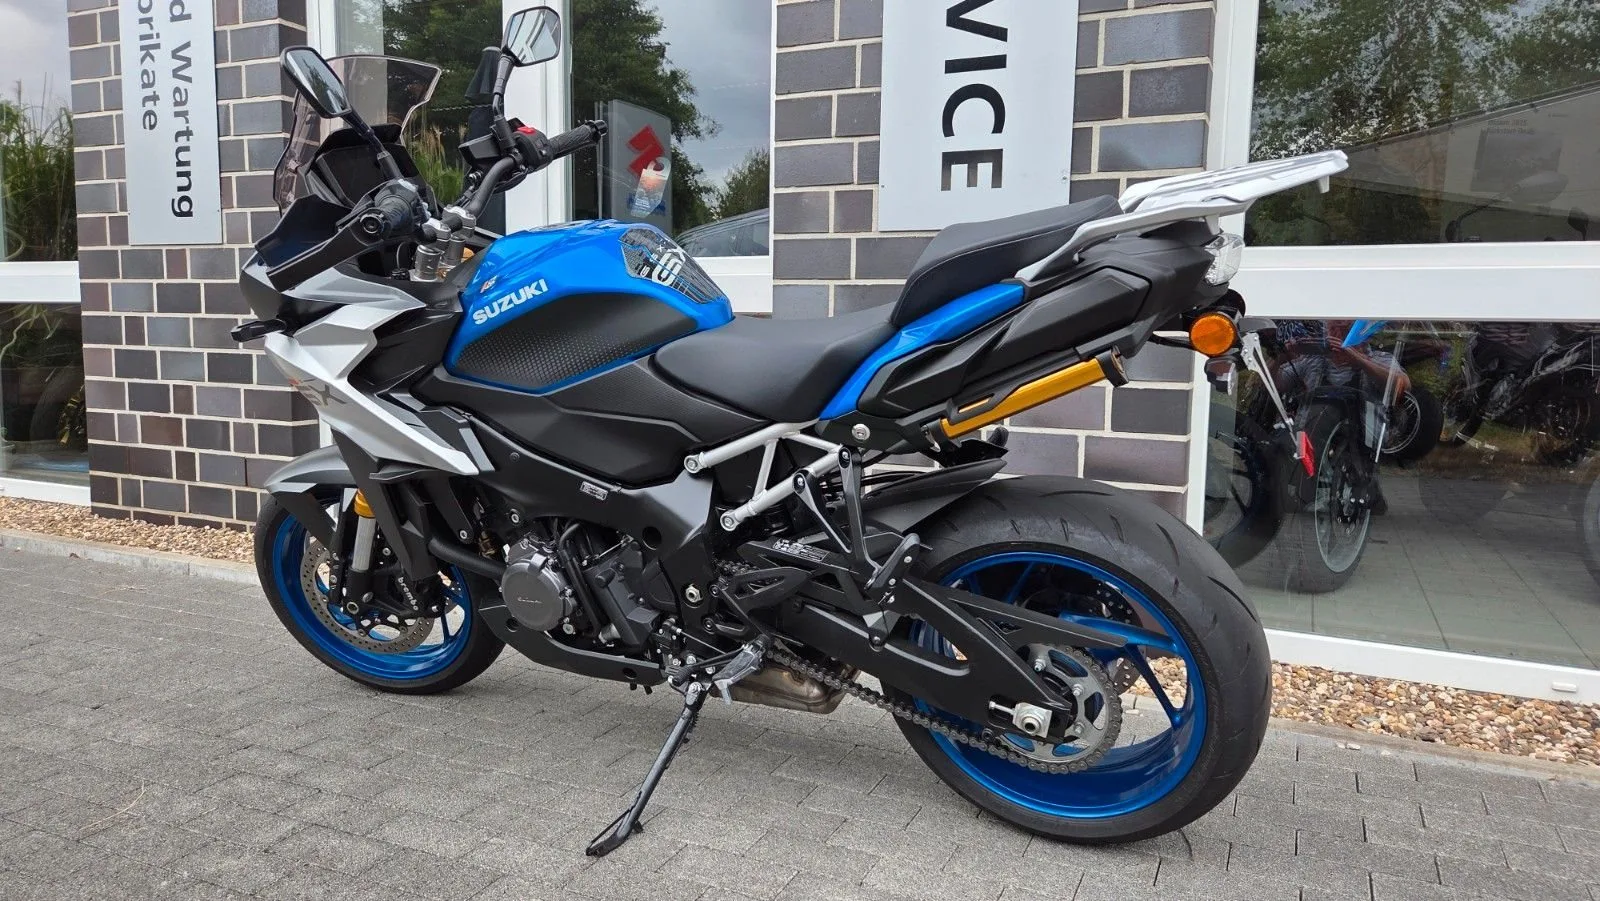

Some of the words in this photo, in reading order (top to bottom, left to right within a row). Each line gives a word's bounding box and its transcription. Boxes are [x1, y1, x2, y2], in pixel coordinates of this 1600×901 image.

[170, 41, 194, 218] Wartung
[941, 0, 1008, 191] VICE
[473, 279, 549, 325] SUZUKI
[398, 577, 419, 611] brembo
